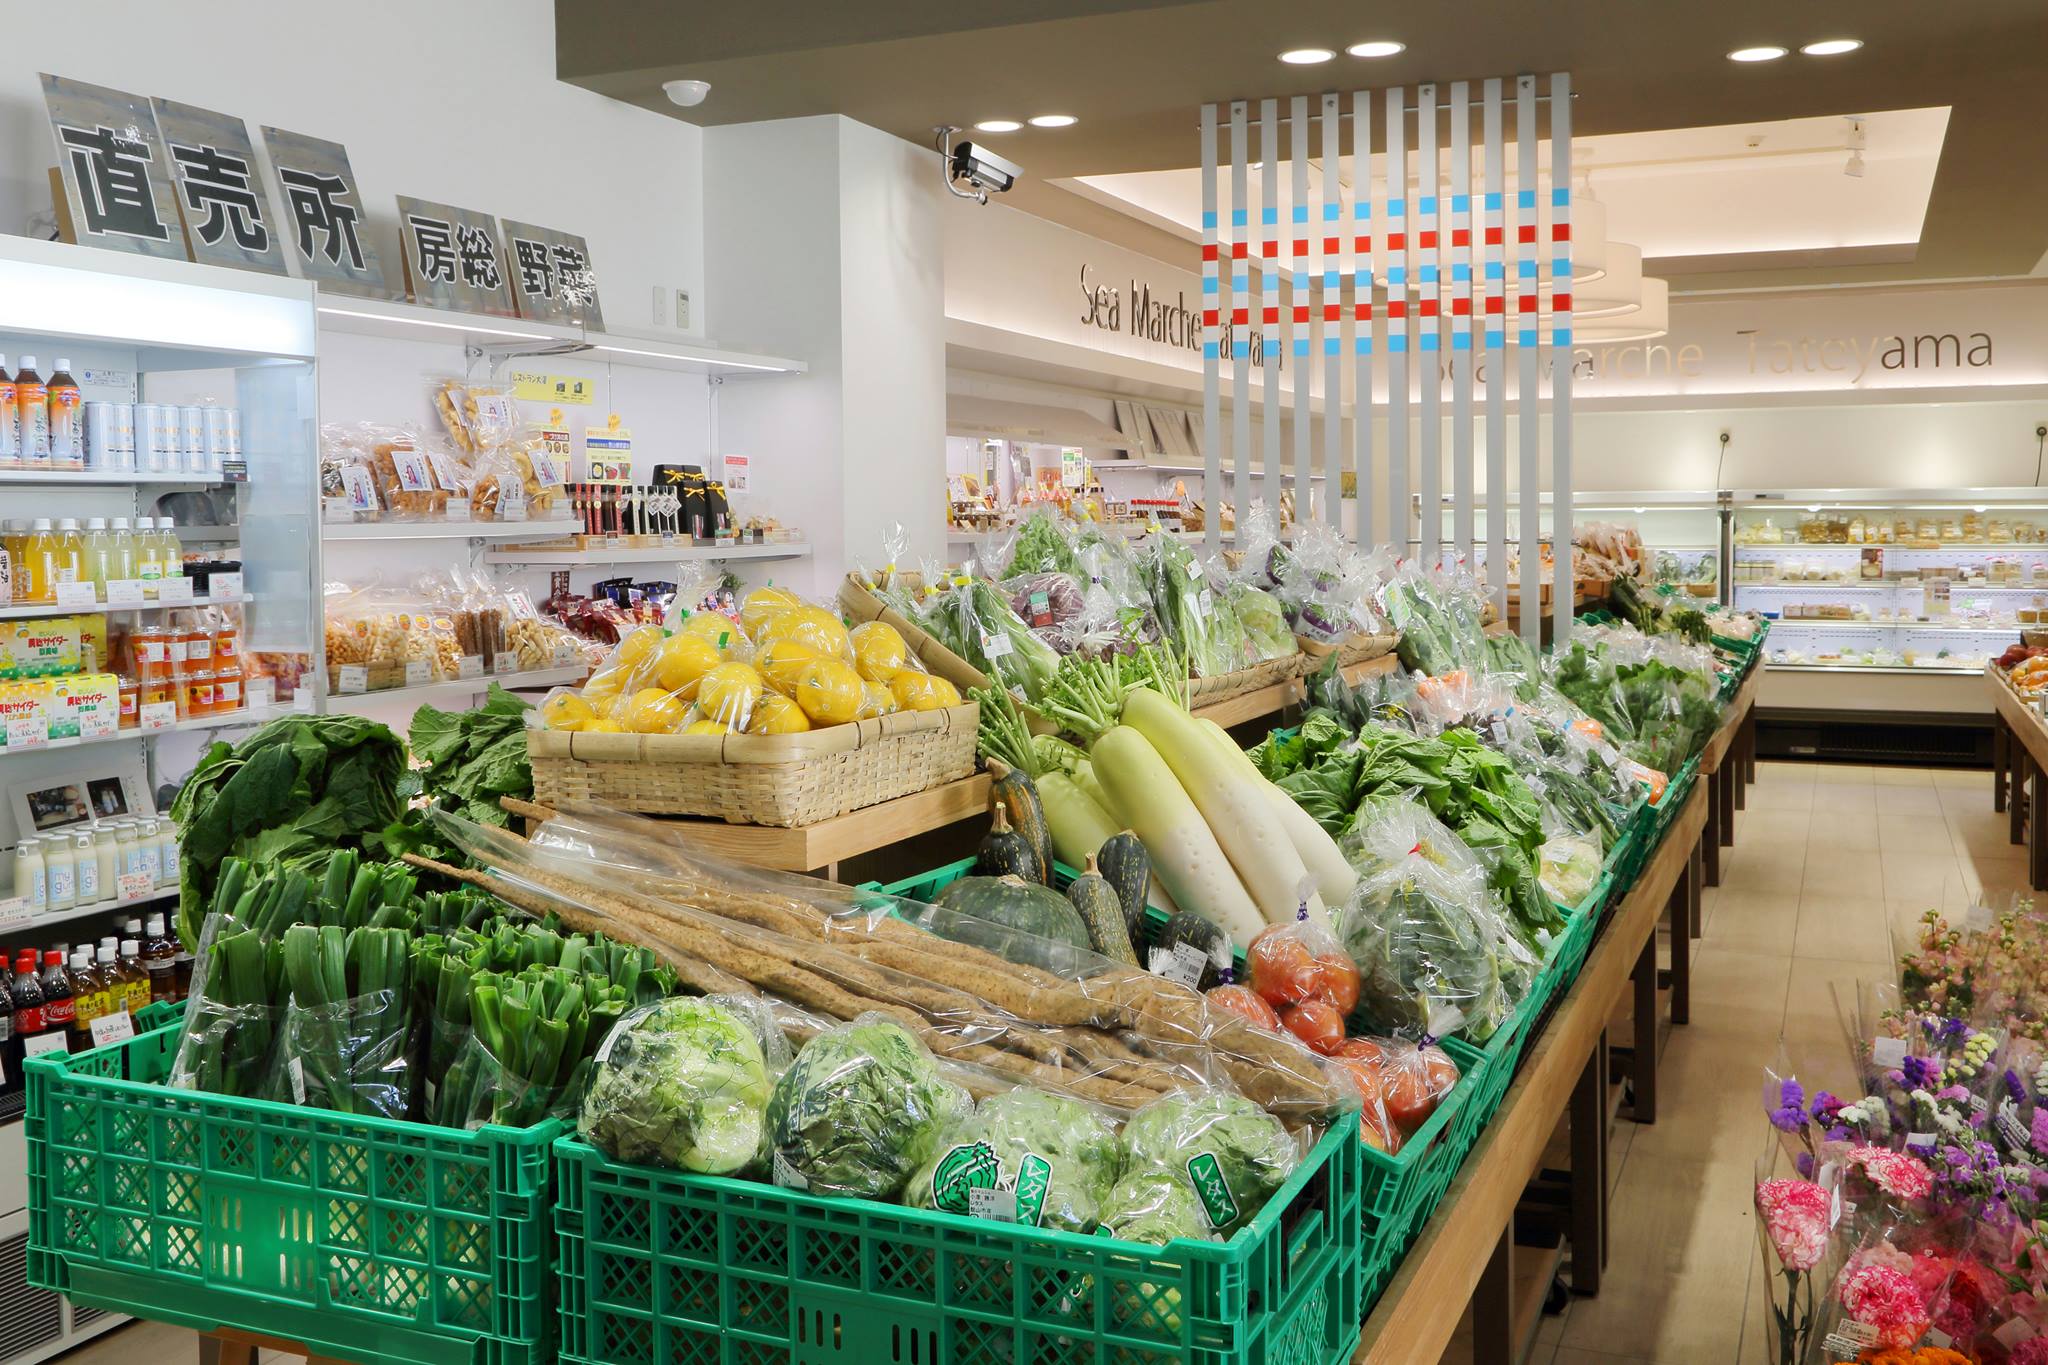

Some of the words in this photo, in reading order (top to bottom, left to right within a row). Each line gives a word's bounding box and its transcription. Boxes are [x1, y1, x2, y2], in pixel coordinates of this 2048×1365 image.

[58, 125, 367, 271] 直売所
[409, 215, 503, 290] 房総
[514, 238, 596, 308] 野菜
[1080, 263, 1121, 332] Sea
[1131, 279, 1203, 352] Marche
[1737, 329, 1994, 385] Tateyama
[1017, 1160, 1047, 1226] レタス
[1193, 1161, 1236, 1223] レタス
